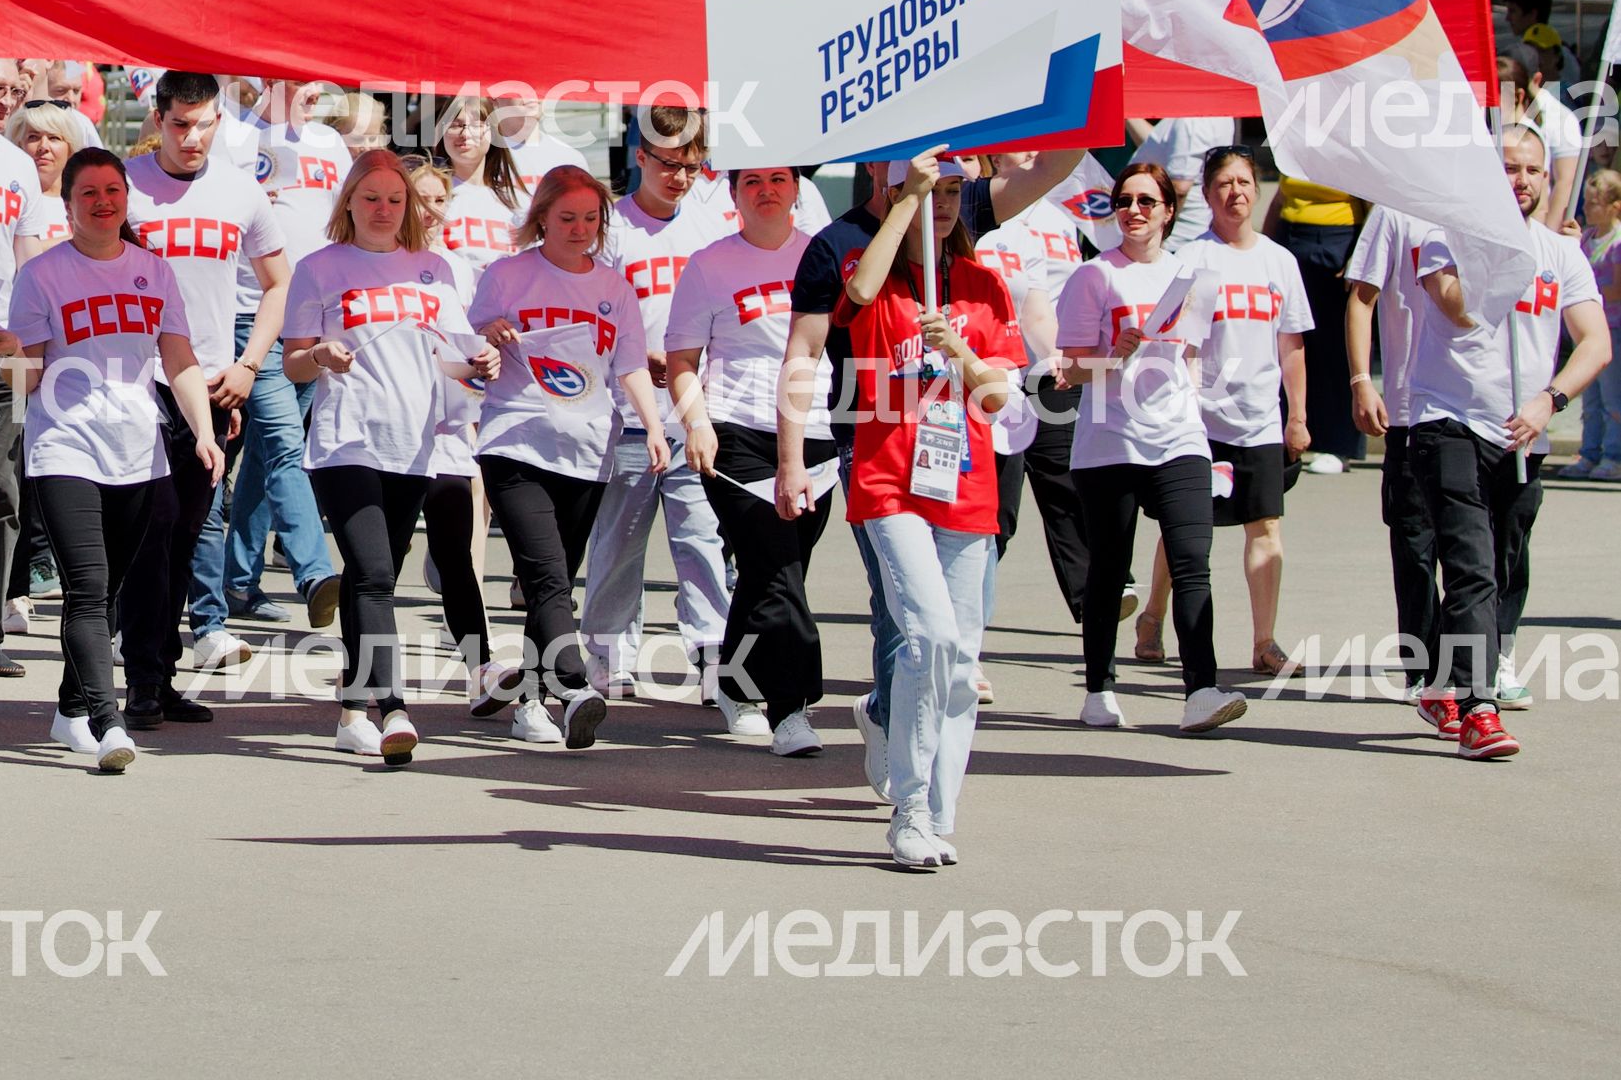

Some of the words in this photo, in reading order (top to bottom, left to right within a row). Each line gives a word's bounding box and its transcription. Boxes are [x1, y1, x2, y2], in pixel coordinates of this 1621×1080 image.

[820, 20, 960, 134] РЕЗЕРВЫ
[61, 294, 164, 346] СССР
[341, 286, 441, 331] СССР
